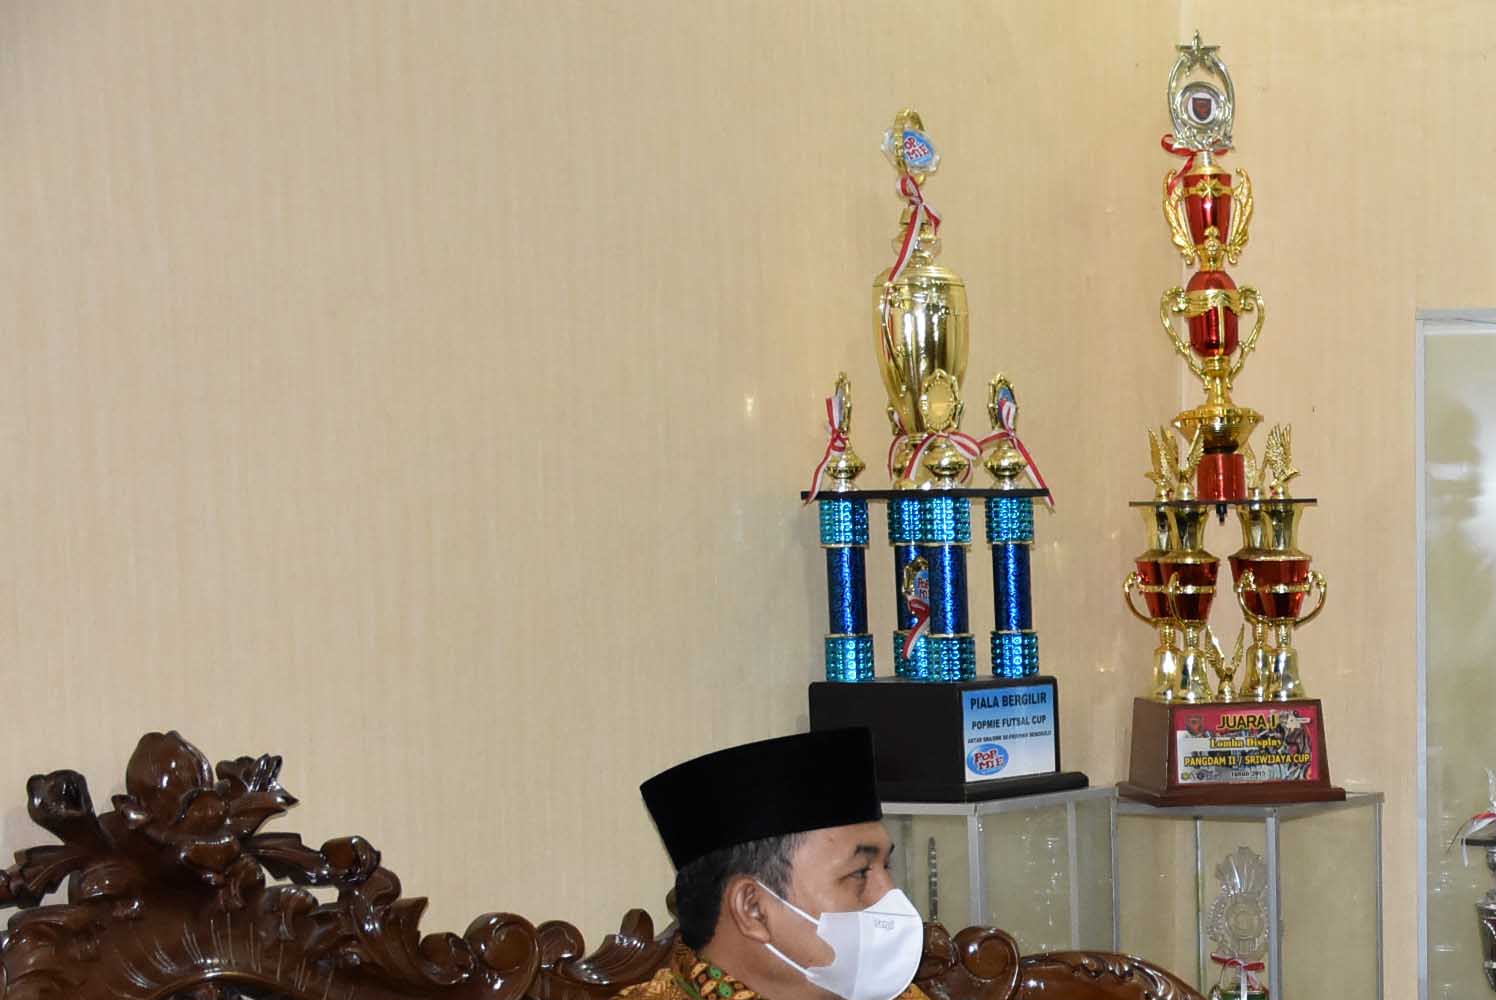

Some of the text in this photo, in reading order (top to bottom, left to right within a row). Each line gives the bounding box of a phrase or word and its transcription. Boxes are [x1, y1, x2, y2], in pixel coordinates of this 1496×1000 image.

[970, 692, 1047, 711] PIALA BERGILIR
[971, 714, 1047, 730] POPMIE FUTSAL CUP
[1216, 714, 1277, 730] JUARA I
[1210, 737, 1282, 749] Lomba Display
[1184, 756, 1226, 767] PANGDAM
[1227, 756, 1236, 766] II
[1244, 754, 1291, 765] SRIWIJAYA
[1293, 753, 1310, 764] CUP
